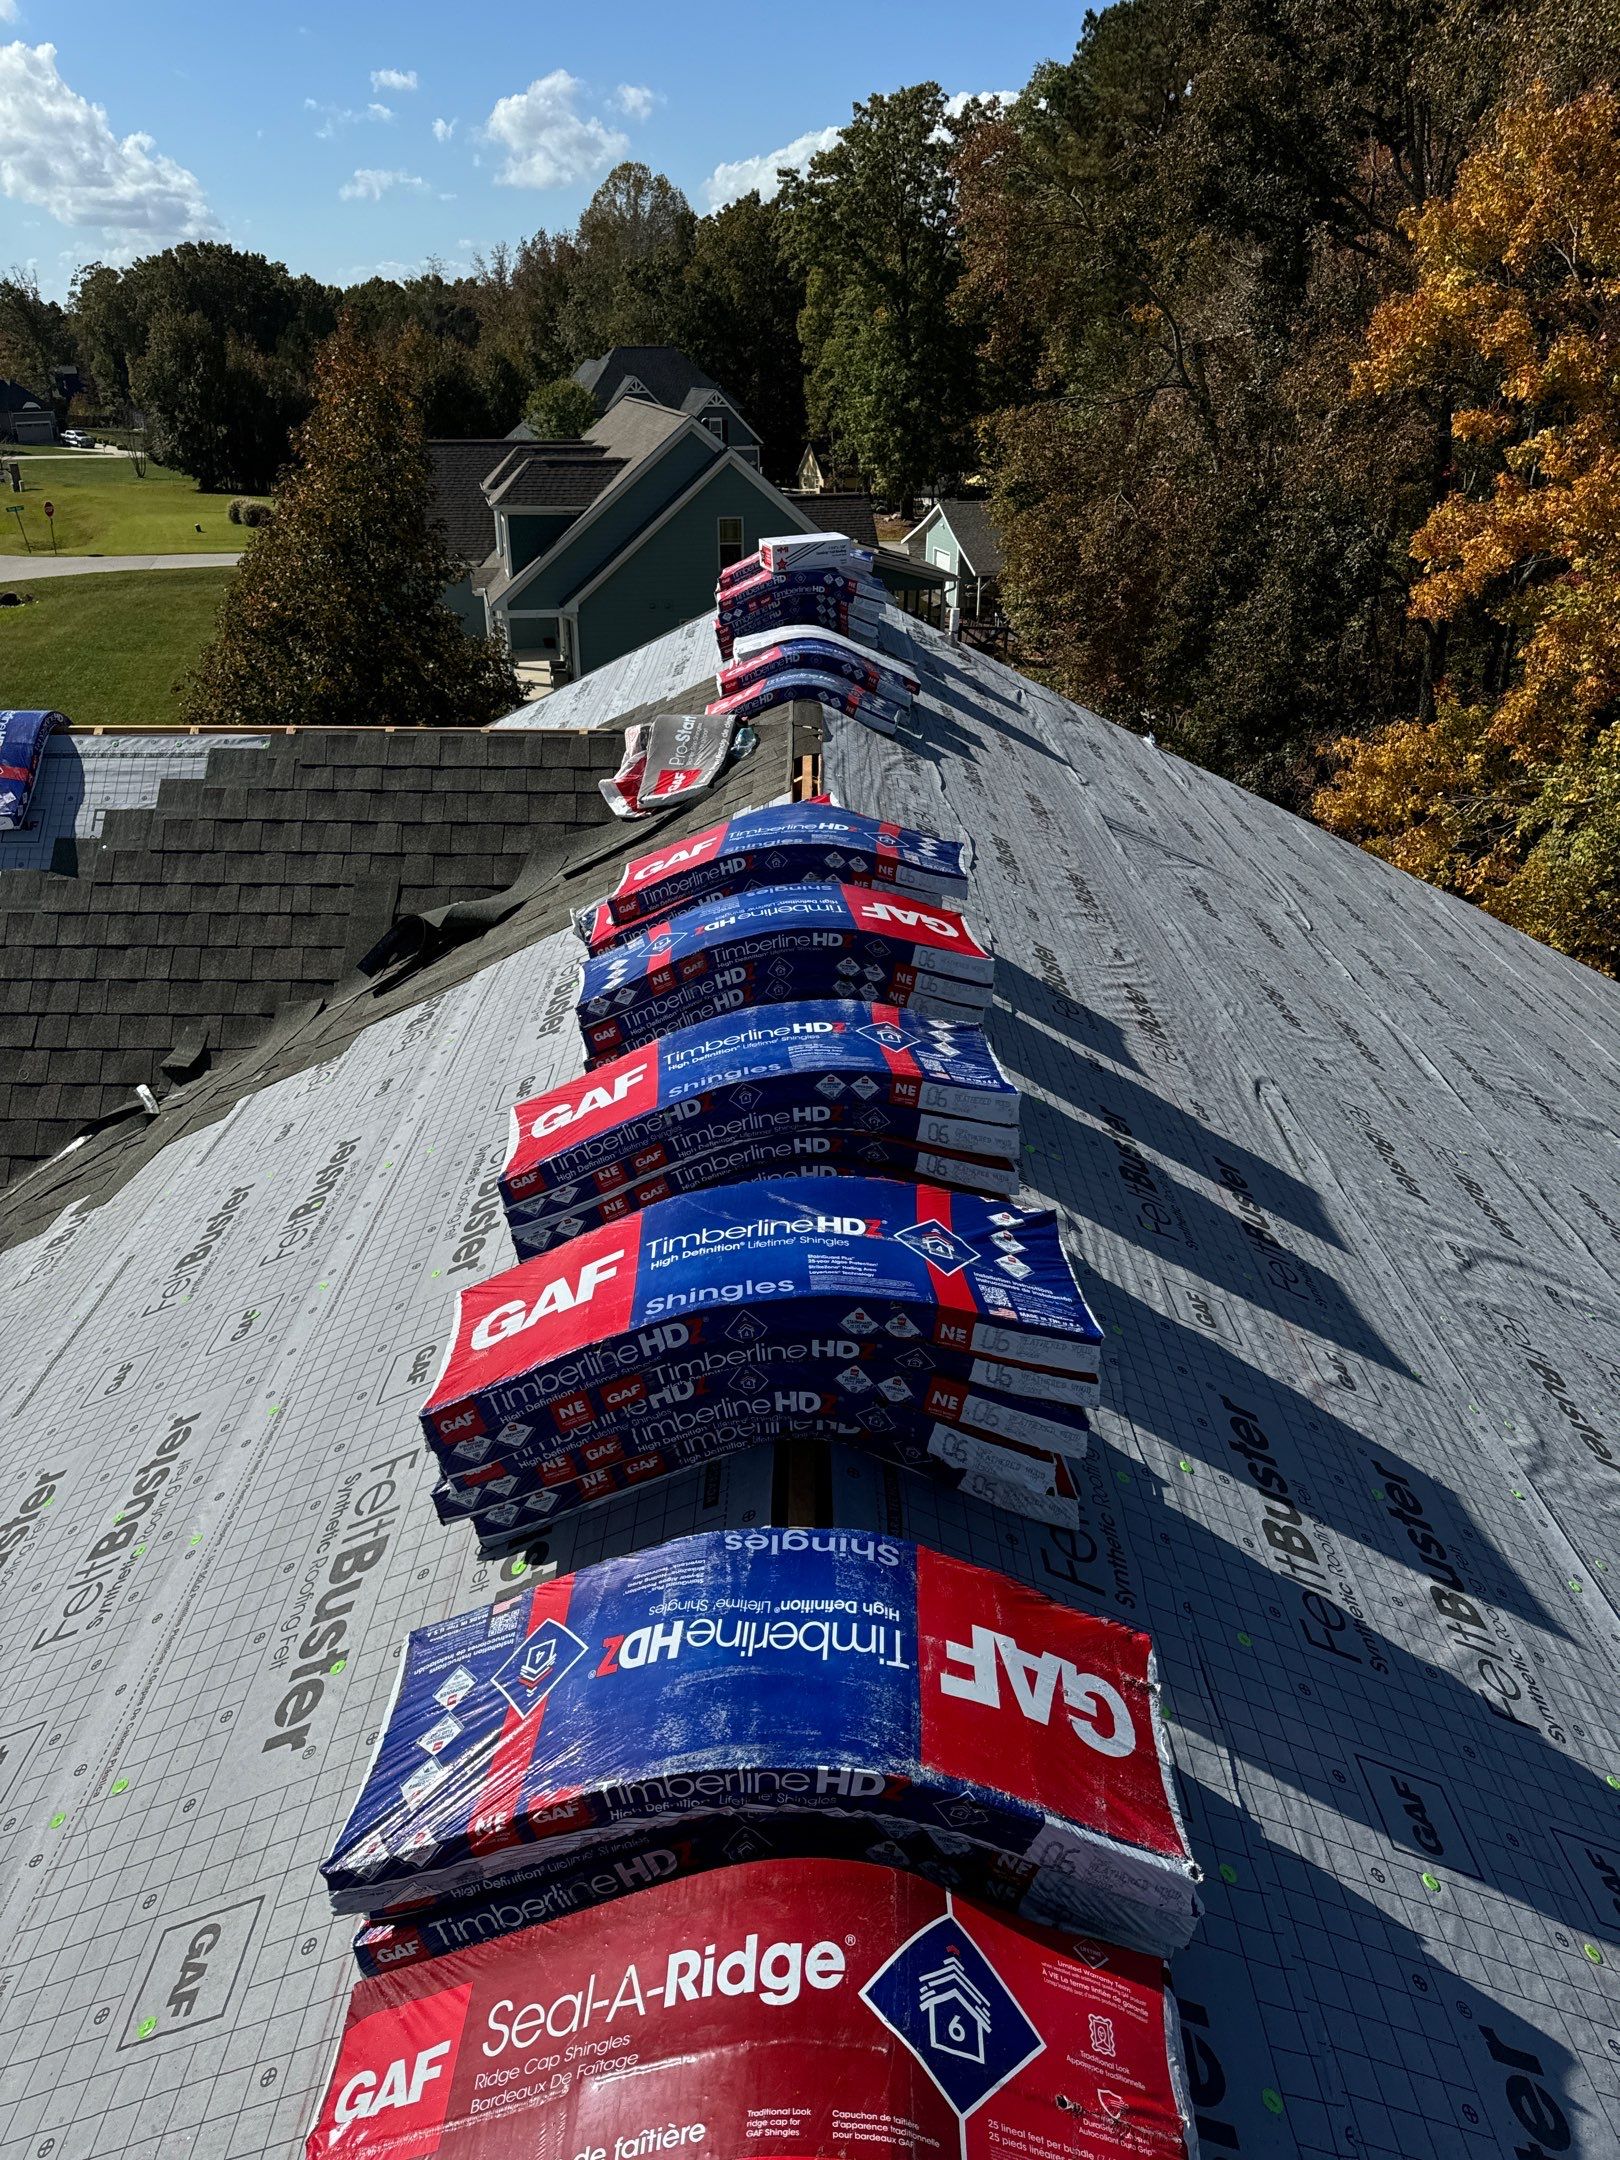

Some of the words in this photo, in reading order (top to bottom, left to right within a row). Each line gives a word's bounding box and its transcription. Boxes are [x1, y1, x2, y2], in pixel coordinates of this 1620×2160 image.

[728, 822, 860, 839] TimberlineHDZ
[633, 837, 717, 881] GAF
[878, 864, 895, 877] NE
[640, 854, 757, 906] TimberlineHDZ
[618, 899, 638, 914] GAF
[694, 901, 847, 936] TimberlineHDZ
[861, 902, 960, 938] GAF
[711, 931, 858, 964] TimberlineHDZ
[652, 972, 671, 985] NE
[896, 972, 914, 985] NE
[1030, 940, 1084, 1026] FeltBuster
[621, 965, 756, 1030] TimberlineHDZ
[593, 1026, 617, 1042] GAF
[662, 1021, 846, 1066] TimberlineHDZ
[1123, 981, 1185, 1071] FeltBuster
[375, 1076, 395, 1098] GAF
[516, 1075, 537, 1100] GAF
[668, 1063, 782, 1099] Shingles
[895, 1084, 917, 1097] NE
[927, 1085, 948, 1108] 06
[530, 1063, 648, 1140] GAF
[274, 1121, 296, 1143] GAF
[547, 1095, 714, 1175] TimberlineHDZ
[669, 1106, 844, 1152] TimberlineHDZ
[598, 1165, 620, 1182] NE
[635, 1149, 663, 1168] GAF
[671, 1136, 845, 1187] TimberlineHDZ
[1097, 1104, 1181, 1243] FeltBuster
[510, 1172, 539, 1190] GAF
[640, 1184, 666, 1201] GAF
[261, 1136, 363, 1268] FeltBuster
[604, 1199, 625, 1215] NE
[1211, 1155, 1311, 1300] FeltBuster
[140, 1181, 257, 1319] FeltBuster
[650, 1254, 679, 1271] High
[799, 1235, 850, 1248] Shingles
[470, 1249, 625, 1350] GAF
[645, 1279, 795, 1315] Shingles
[1186, 1289, 1218, 1330] GAF
[230, 1308, 258, 1343] GAF
[940, 1323, 967, 1345] NE
[104, 1361, 136, 1397] GAF
[406, 1344, 438, 1386] GAF
[482, 1319, 705, 1417] TimberlineHDZ
[653, 1339, 876, 1385] TimberlineHDZ
[1322, 1351, 1359, 1393] GAF
[606, 1384, 641, 1405] GAF
[932, 1390, 958, 1410] NE
[1491, 1308, 1620, 1474] FeltBuster
[439, 1410, 477, 1434] GAF
[499, 1407, 526, 1425] High
[558, 1400, 587, 1420] NE
[585, 1441, 618, 1462] GAF
[627, 1457, 659, 1475] GAF
[582, 1470, 608, 1489] NE
[1292, 1478, 1315, 1508] Felt
[133, 1482, 182, 1547] Roofing
[168, 1457, 194, 1487] Felt
[315, 1471, 362, 1556] Synthetic
[1218, 1393, 1363, 1665] FeltBuster
[1312, 1508, 1347, 1578] Roofing
[724, 1530, 900, 1567] Shingles
[1101, 1511, 1137, 1610] Synthetic
[1449, 1544, 1474, 1575] Felt
[279, 1557, 331, 1633] Roofing
[649, 1599, 708, 1618] Shingles
[862, 1601, 900, 1622] High
[1370, 1459, 1543, 1734] FeltBuster
[1467, 1575, 1514, 1646] Roofing
[1338, 1581, 1390, 1676] Synthetic
[267, 1635, 300, 1674] Felt
[473, 1638, 514, 1657] Installation
[940, 1624, 1137, 1758] GAF
[1508, 1647, 1567, 1745] Synthetic
[597, 1765, 909, 1812] TimberlineHDZ
[475, 1811, 508, 1836] NE
[533, 1799, 580, 1826] GAF
[1390, 1773, 1446, 1858] GAF
[1040, 1841, 1080, 1877] 06
[429, 1842, 695, 1947] TimberlineHDZ
[166, 1921, 222, 2019] GAF
[376, 1939, 421, 1965] GAF
[948, 2015, 967, 2043] 6
[474, 2061, 520, 2092] Ridge
[523, 2050, 562, 2074] Cap
[563, 2034, 631, 2067] Shingles
[1080, 2050, 1115, 2071] Traditional
[1115, 2063, 1131, 2076] Look
[334, 2040, 452, 2125] GAF
[470, 2079, 547, 2116] Bardeaux
[548, 2072, 571, 2089] De
[746, 2117, 768, 2129] ridge
[769, 2118, 788, 2129] cap
[789, 2117, 801, 2126] for
[747, 2107, 791, 2118] Traditional
[792, 2107, 812, 2117] Look
[831, 2108, 878, 2122] Capuchon
[879, 2113, 892, 2122] de
[613, 2122, 706, 2160] faîtière
[746, 2127, 763, 2138] GAF
[764, 2126, 800, 2139] Shingles
[831, 2130, 854, 2142] pour
[854, 2131, 898, 2144] bardeaux
[890, 2123, 941, 2150] traditionnelle
[987, 2118, 1000, 2131] 25
[1000, 2120, 1027, 2138] lineal
[1027, 2131, 1045, 2146] feet
[1045, 2138, 1063, 2152] per
[1063, 2142, 1096, 2160] bundle
[988, 2131, 1001, 2144] 25
[1002, 2135, 1028, 2152] pieds
[1079, 2126, 1120, 2146] Autocollant
